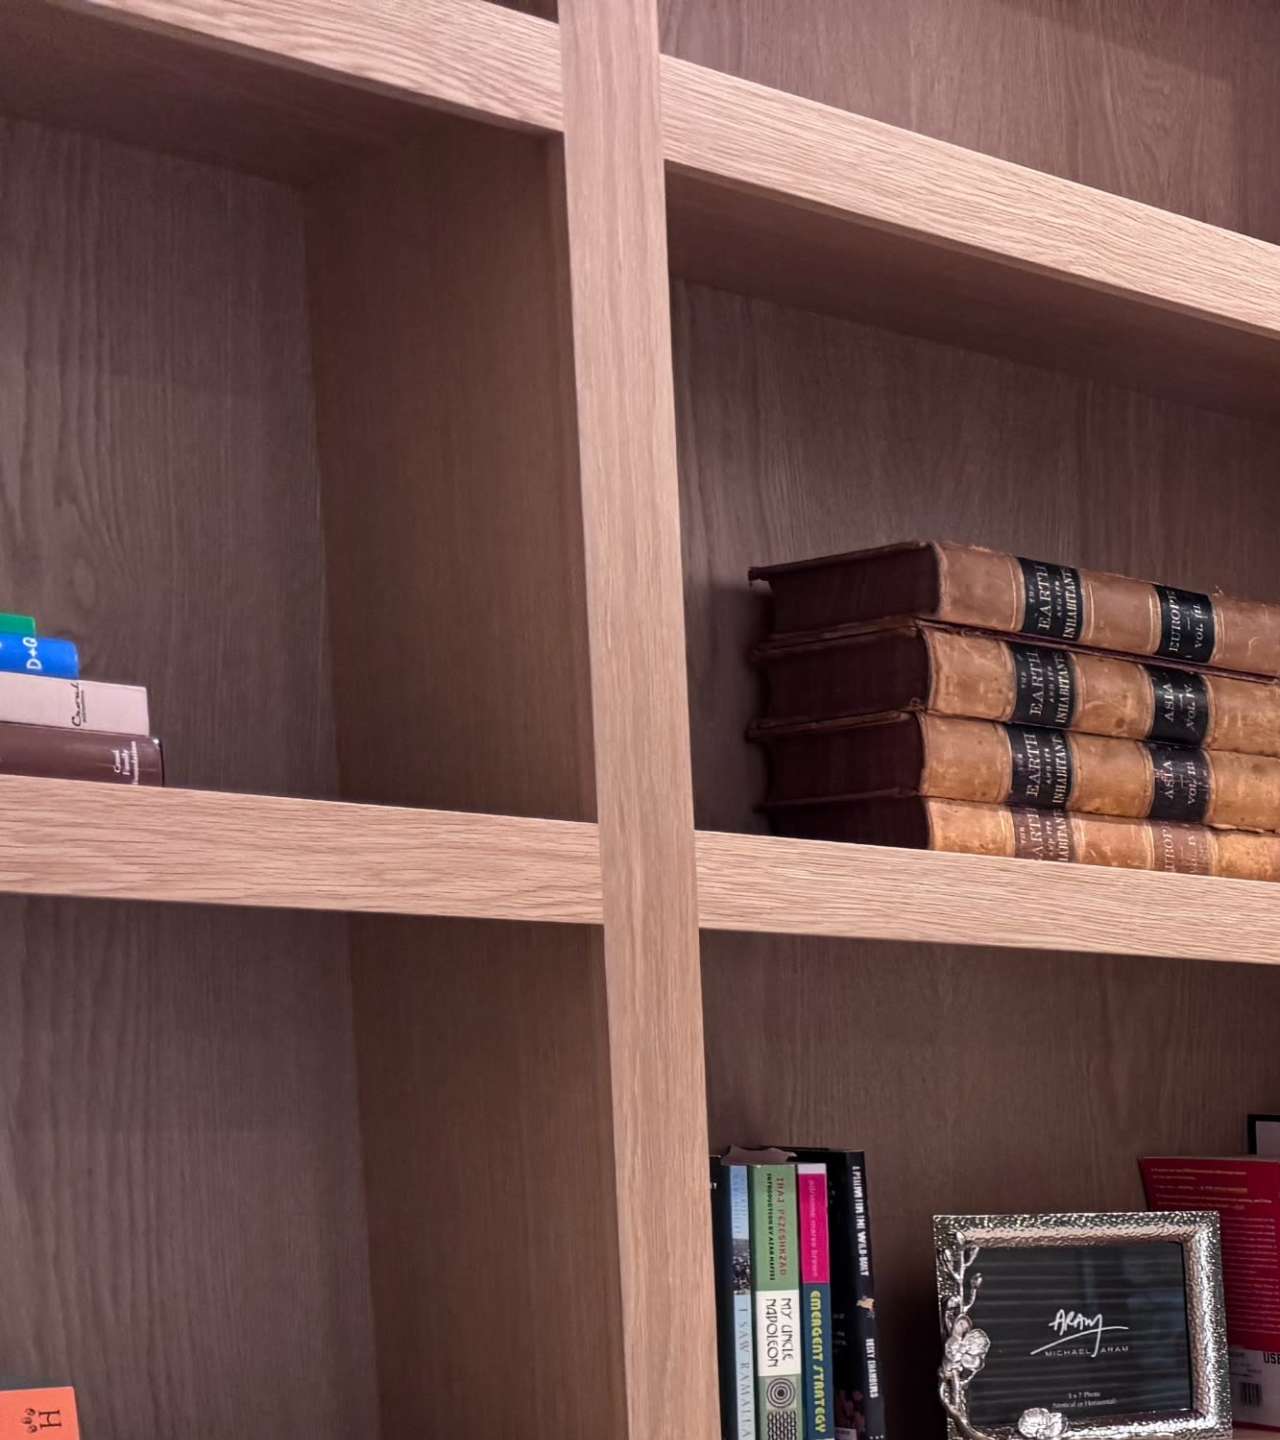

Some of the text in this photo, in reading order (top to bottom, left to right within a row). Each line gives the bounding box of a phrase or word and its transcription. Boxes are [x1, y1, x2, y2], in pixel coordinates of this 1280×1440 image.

[1035, 565, 1052, 631] EARTH
[1026, 651, 1044, 716] EARTH
[1161, 682, 1176, 723] ASIA
[1023, 733, 1041, 797] EARTH
[1024, 808, 1043, 861] ARTH
[739, 1320, 750, 1354] SAW
[766, 1298, 780, 1368] NAPOLEON
[780, 1297, 795, 1362] MY UNCLE
[1044, 1345, 1129, 1357] MICHAEL ARAM
